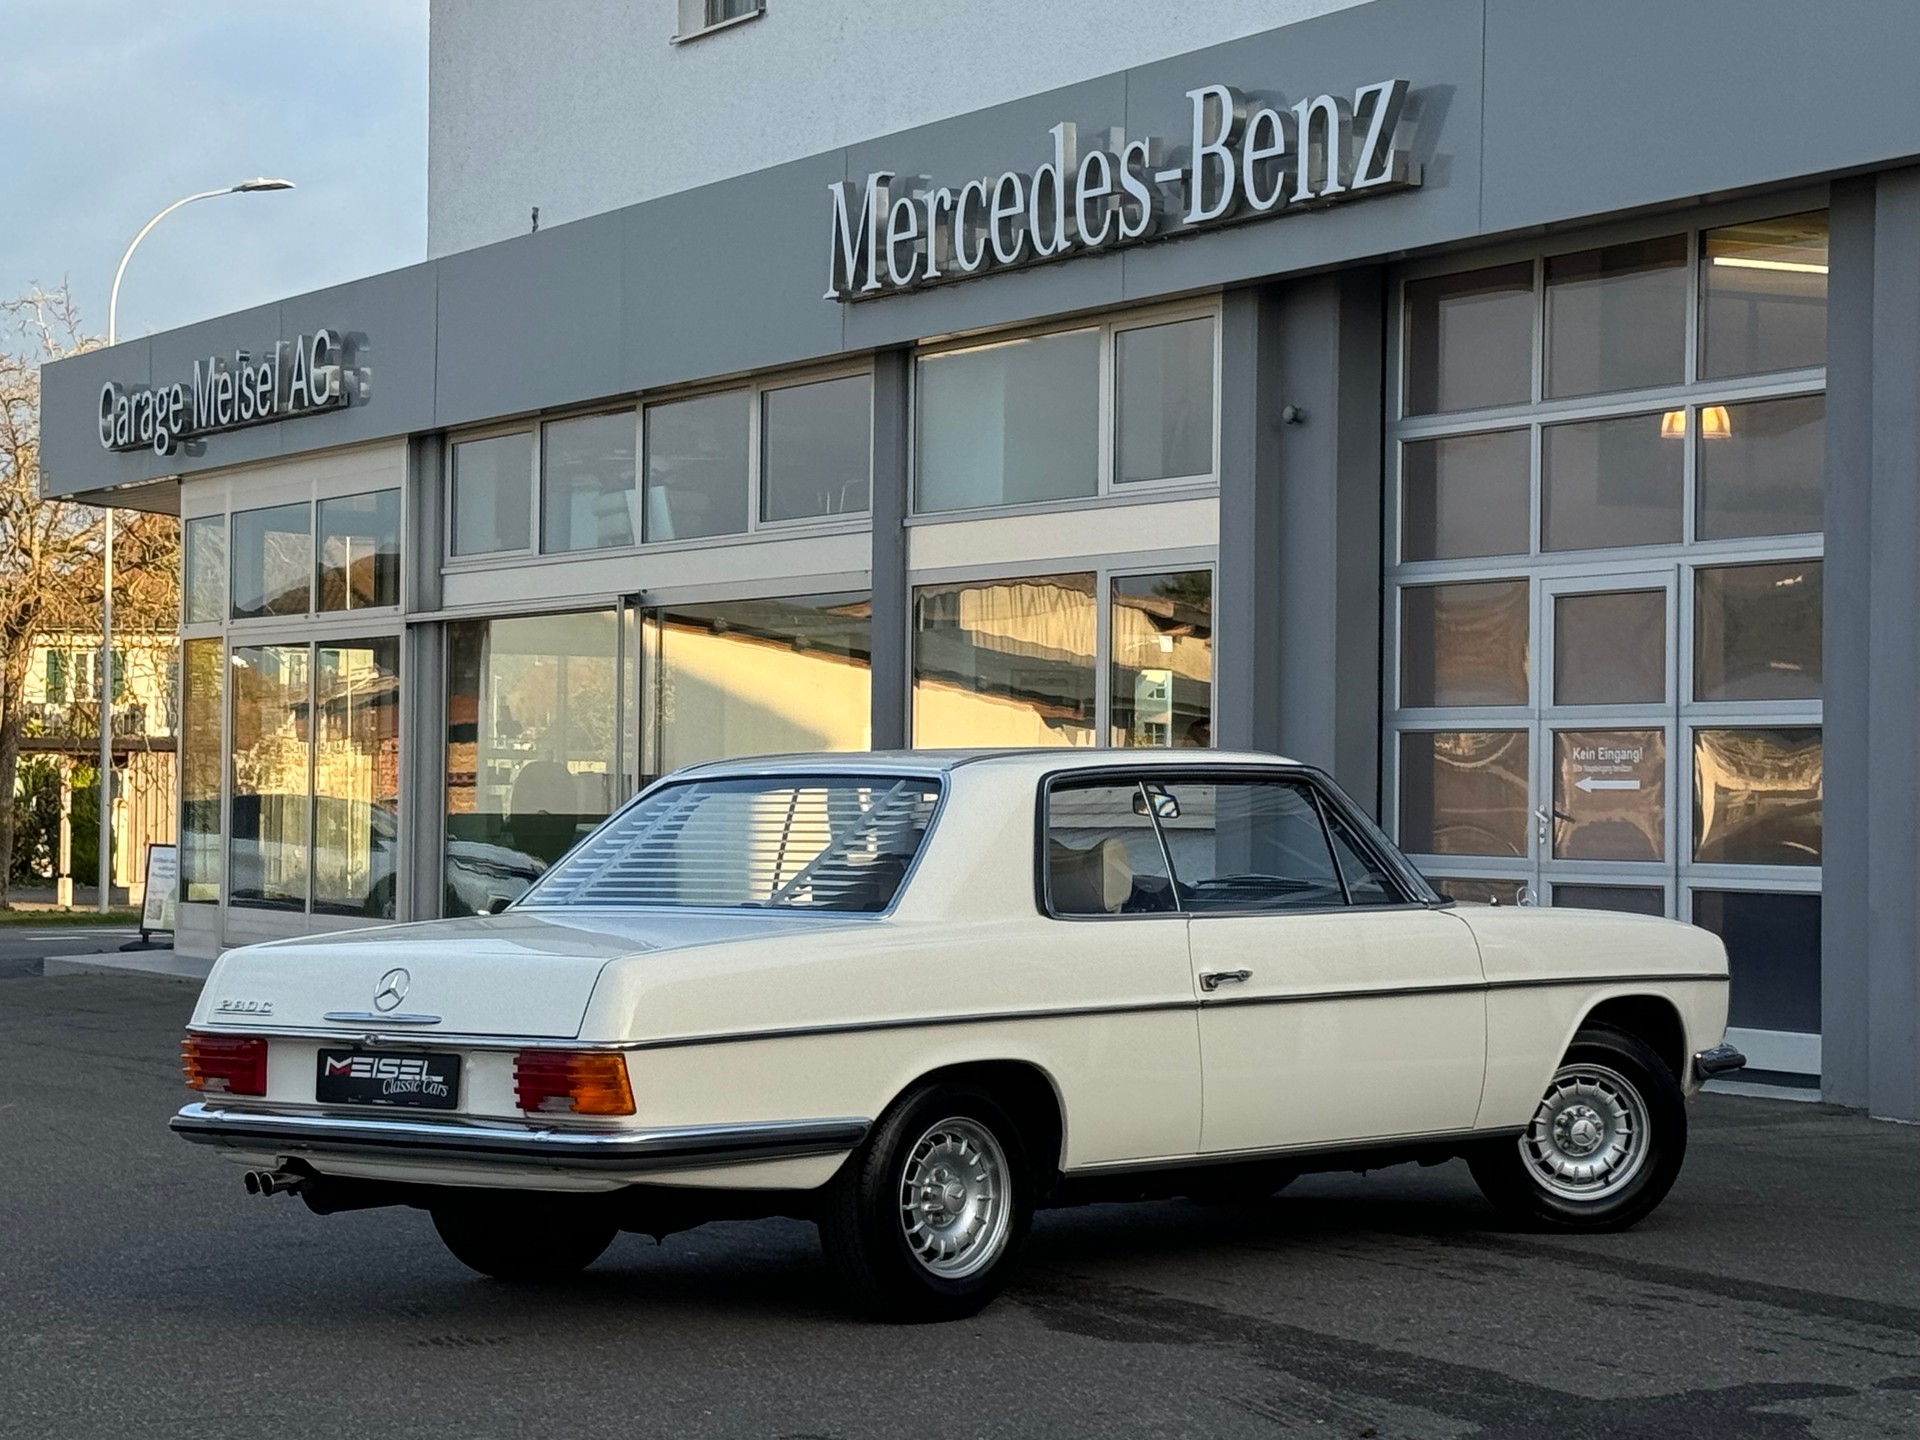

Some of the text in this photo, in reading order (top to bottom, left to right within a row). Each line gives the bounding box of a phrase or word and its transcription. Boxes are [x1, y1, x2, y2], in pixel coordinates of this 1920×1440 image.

[823, 79, 1408, 300] Mercedes-Benz
[100, 329, 333, 456] Garage Meisel AG
[1572, 746, 1643, 763] Kein Eingang!
[325, 1056, 444, 1082] MEISEL
[382, 1078, 449, 1098] Classic Cars
